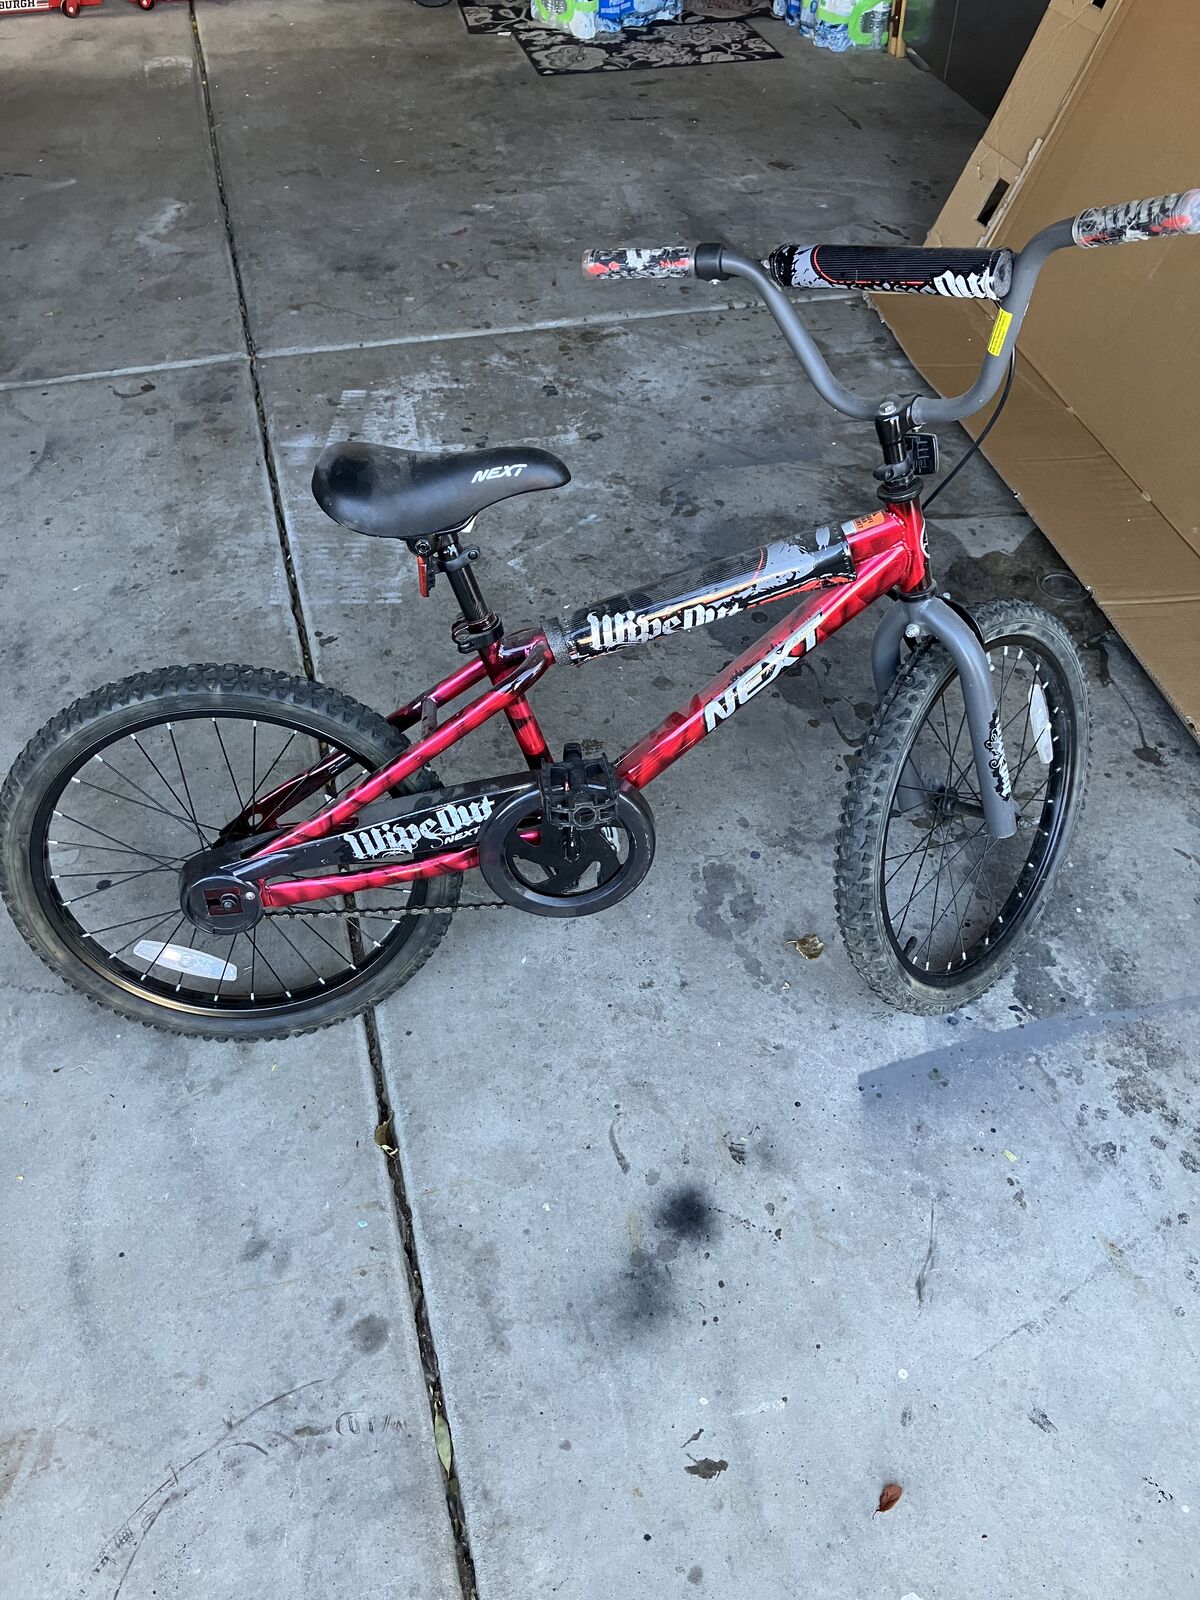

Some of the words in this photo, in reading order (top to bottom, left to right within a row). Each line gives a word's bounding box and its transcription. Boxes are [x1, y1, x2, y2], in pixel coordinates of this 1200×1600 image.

[471, 463, 528, 484] NEXT
[703, 608, 823, 733] NEXT
[444, 825, 481, 845] NEXT
